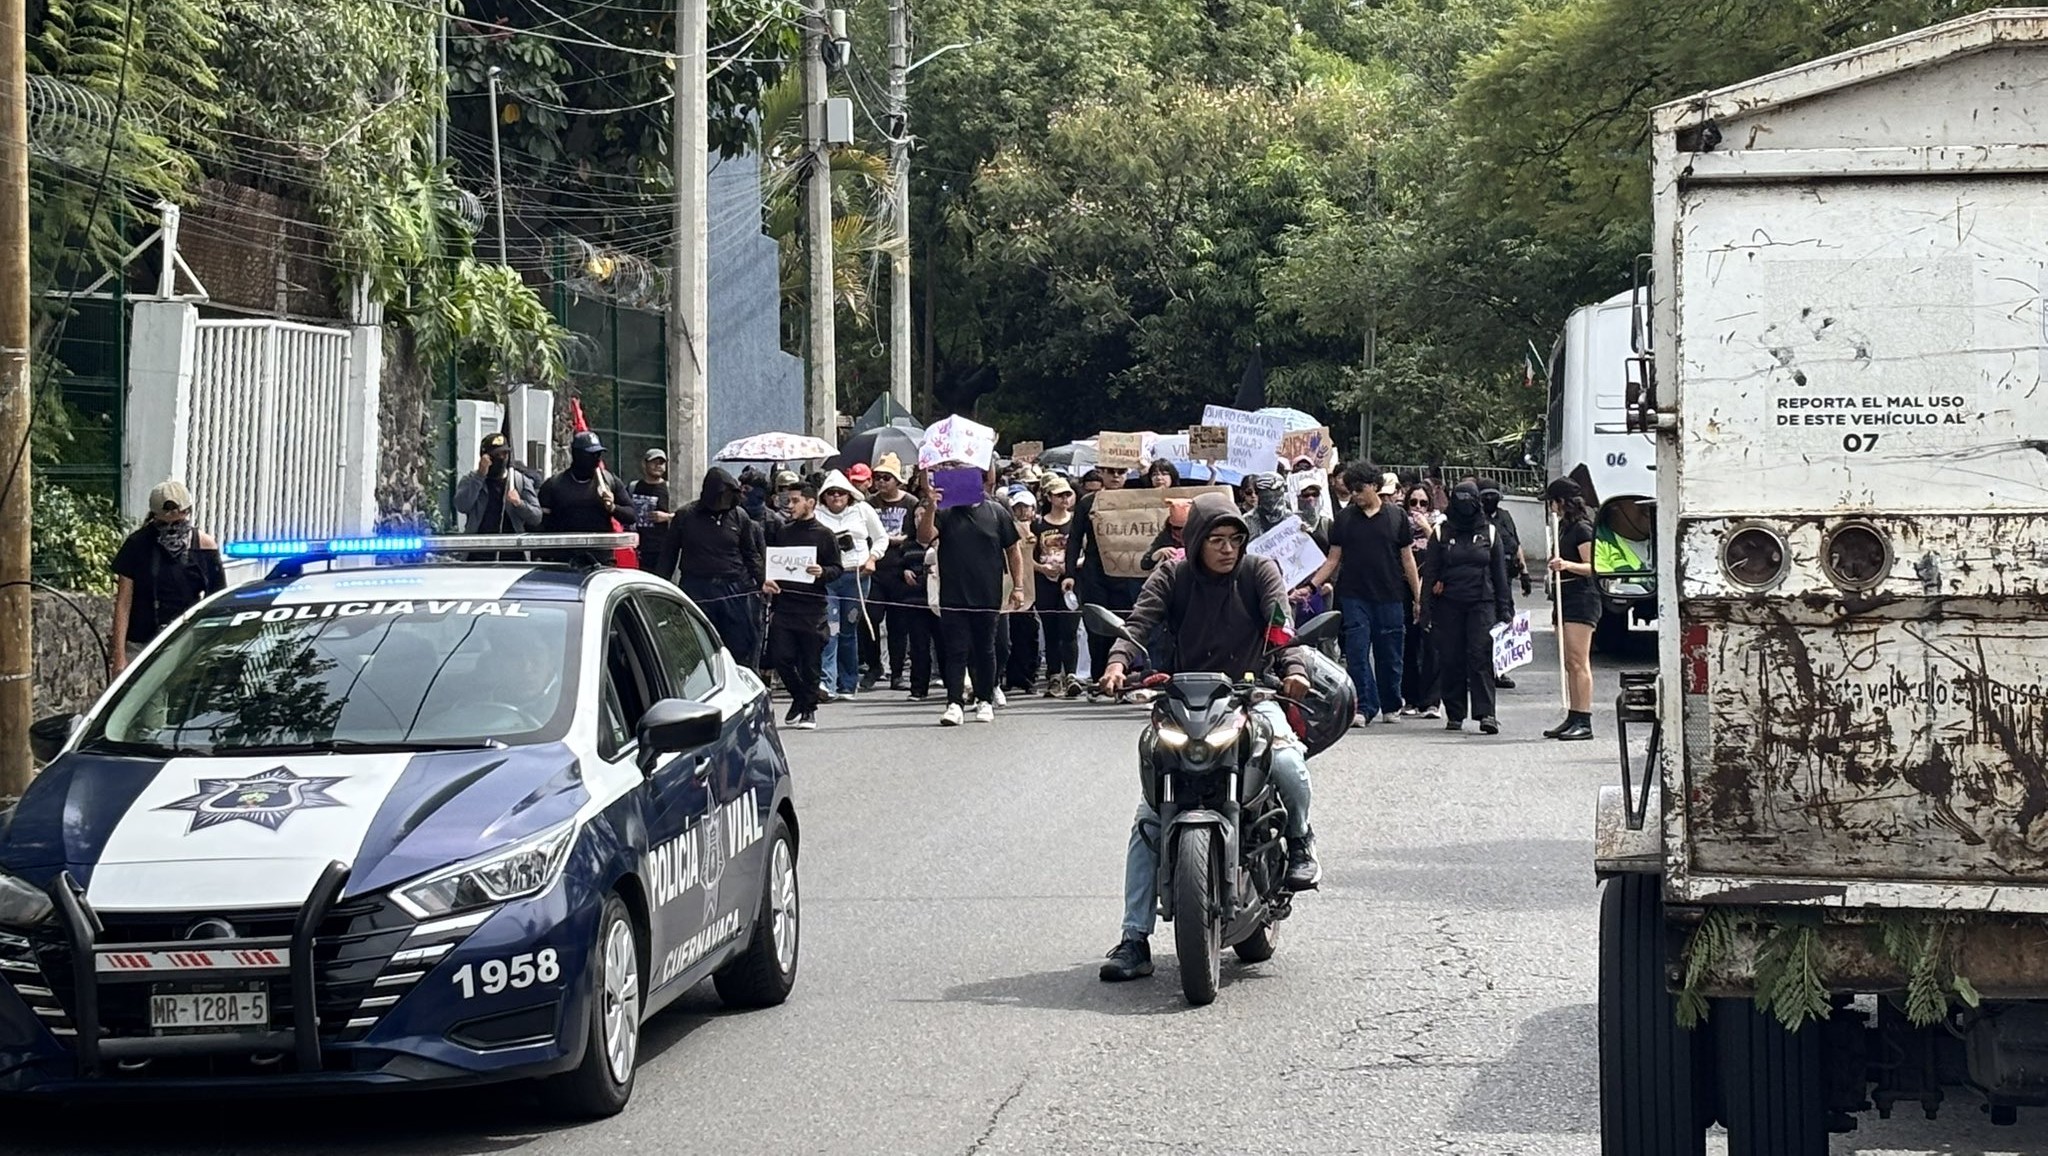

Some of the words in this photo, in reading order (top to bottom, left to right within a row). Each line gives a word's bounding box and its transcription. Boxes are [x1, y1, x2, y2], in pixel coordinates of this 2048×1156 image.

[1777, 397, 1857, 409] REPORTA
[1862, 397, 1883, 408] EL
[1887, 396, 1924, 408] MAL
[1928, 395, 1965, 408] USO
[1776, 414, 1800, 426] DE
[1804, 414, 1847, 426] ESTE
[1851, 411, 1938, 426] VEHÍCULO
[1943, 413, 1967, 425] AL
[1842, 433, 1880, 453] 07
[1606, 452, 1628, 468] 06
[230, 600, 416, 627] POLICIA
[427, 600, 531, 618] VIAL
[648, 815, 700, 913] POLICÍA
[726, 786, 764, 860] VIAL
[662, 907, 745, 984] CUERNAVACA
[451, 947, 560, 999] 1958
[152, 994, 264, 1025] MR-128A-5
